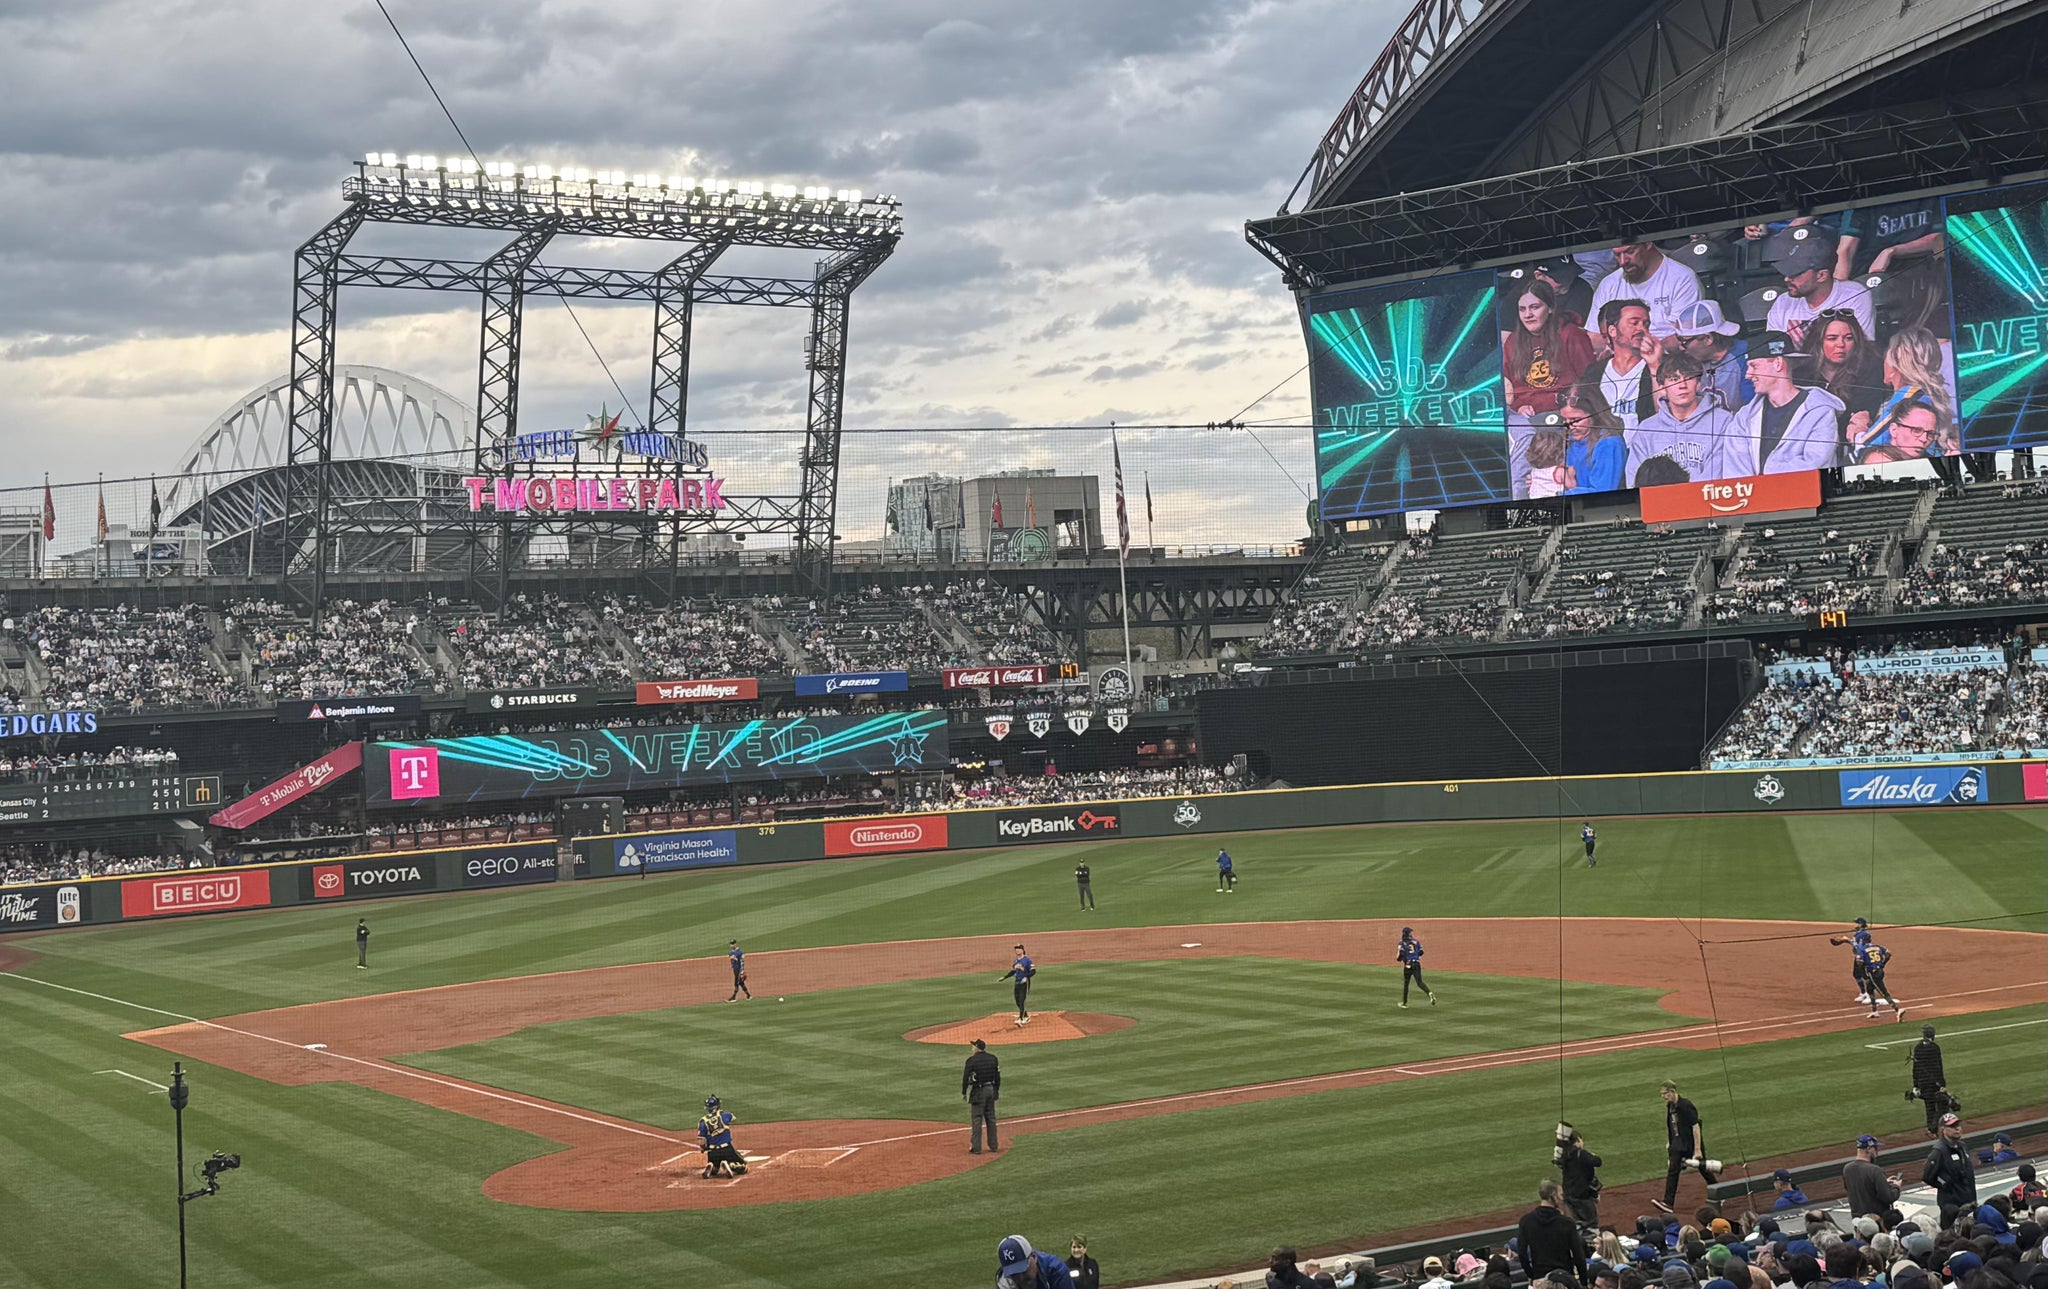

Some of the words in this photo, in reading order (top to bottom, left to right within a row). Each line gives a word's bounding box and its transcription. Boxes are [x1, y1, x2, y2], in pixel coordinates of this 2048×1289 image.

[1963, 313, 2048, 357] WE
[1324, 387, 1497, 437] WEEKEND
[491, 428, 575, 468] SEATTLE
[623, 432, 709, 470] MARINERS
[463, 477, 631, 513] T-MOBILE
[637, 477, 728, 512] PARK
[1701, 483, 1733, 501] fire
[1735, 481, 1754, 498] tv
[1820, 610, 1847, 629] 1:47
[1877, 658, 1922, 669] J-ROD
[1931, 654, 1981, 666] SQUAD
[839, 678, 881, 688] BOEING
[958, 671, 991, 686] Coca-Cola
[1002, 668, 1035, 684] Coca-Cola
[508, 693, 578, 706] STARBUCKS
[325, 705, 366, 717] Benjamin
[366, 705, 395, 714] Moore
[992, 722, 1007, 736] 42
[1032, 720, 1047, 733] 24
[1073, 718, 1084, 730] 11
[1112, 716, 1124, 728] 51
[616, 725, 822, 775] WEEKEND
[1835, 756, 1869, 765] J-ROD
[1875, 755, 1912, 763] SQUAD
[401, 756, 428, 790] T
[163, 778, 170, 786] H
[174, 777, 180, 785] E
[270, 779, 305, 802] Mobile
[299, 761, 334, 788] Pen
[1443, 783, 1459, 793] 401
[1759, 780, 1779, 793] 50
[1848, 774, 1937, 801] Alaska
[23, 797, 37, 807] City
[42, 797, 49, 806] 4
[152, 789, 159, 798] 4
[163, 788, 170, 797] 5
[174, 788, 180, 797] 0
[0, 811, 29, 820] Seattle
[42, 809, 49, 818] 2
[152, 801, 160, 810] 2
[1179, 806, 1196, 818] 50
[758, 826, 776, 836] 376
[999, 815, 1076, 838] KeyBank
[856, 827, 916, 843] Nintendo
[644, 840, 680, 854] Virginia
[682, 838, 713, 849] Mason
[645, 849, 696, 863] Franciscan
[697, 846, 730, 859] Health
[467, 857, 519, 877] eero
[350, 866, 422, 886] TOYOTA
[0, 893, 22, 905] IT'S
[161, 882, 235, 903] BECU
[0, 896, 40, 921] Miller
[11, 910, 39, 922] TIME
[1408, 943, 1415, 954] 3
[1868, 950, 1881, 963] 56
[1003, 1249, 1015, 1261] KC
